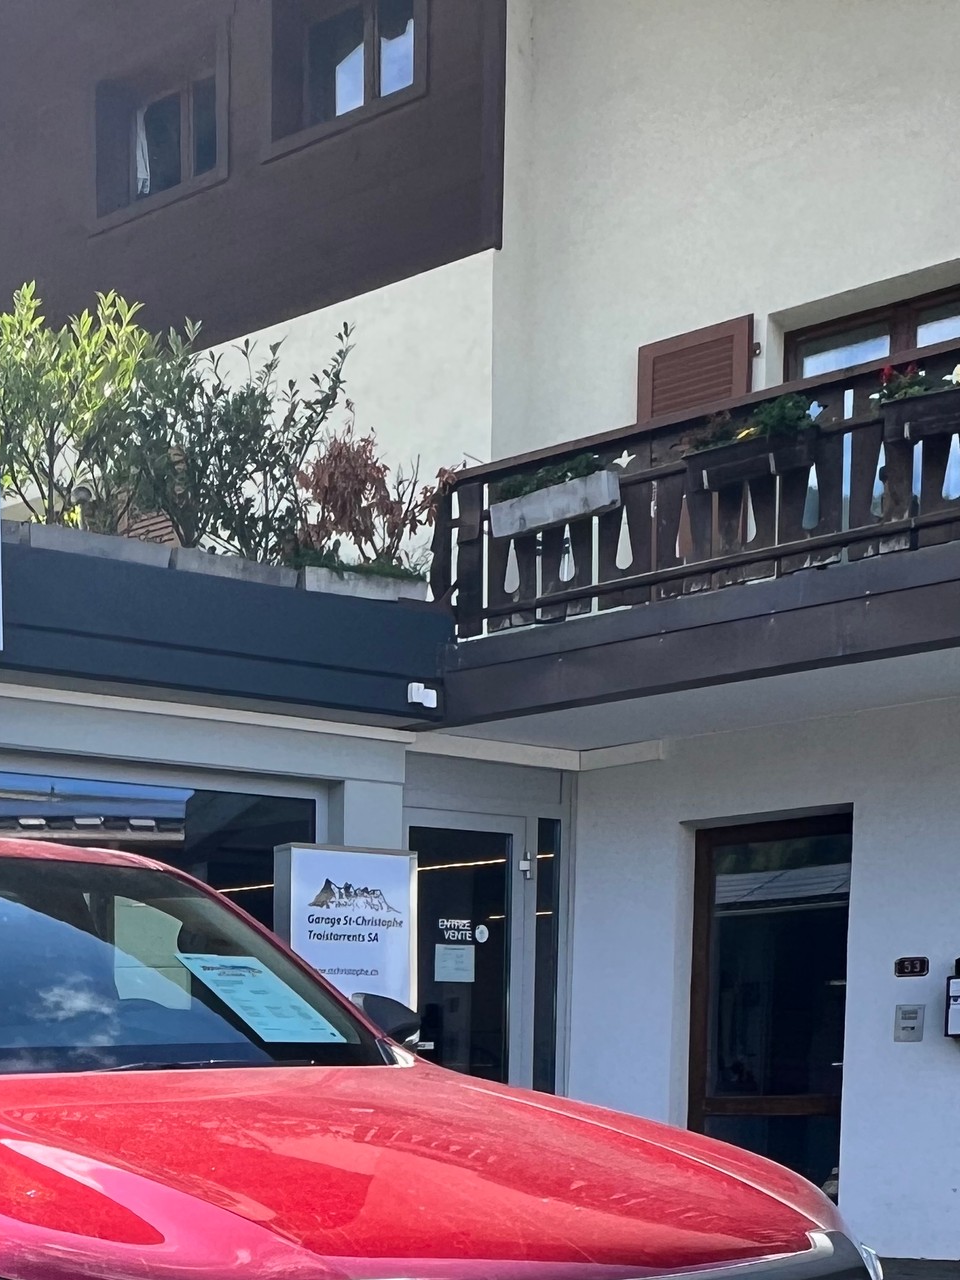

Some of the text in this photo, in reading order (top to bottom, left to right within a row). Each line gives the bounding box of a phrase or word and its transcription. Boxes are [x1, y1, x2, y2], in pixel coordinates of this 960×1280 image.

[307, 914, 403, 930] Garage St-Christophe
[308, 929, 379, 943] Troistorrents SA
[444, 930, 473, 941] VENTE
[904, 961, 921, 973] 53
